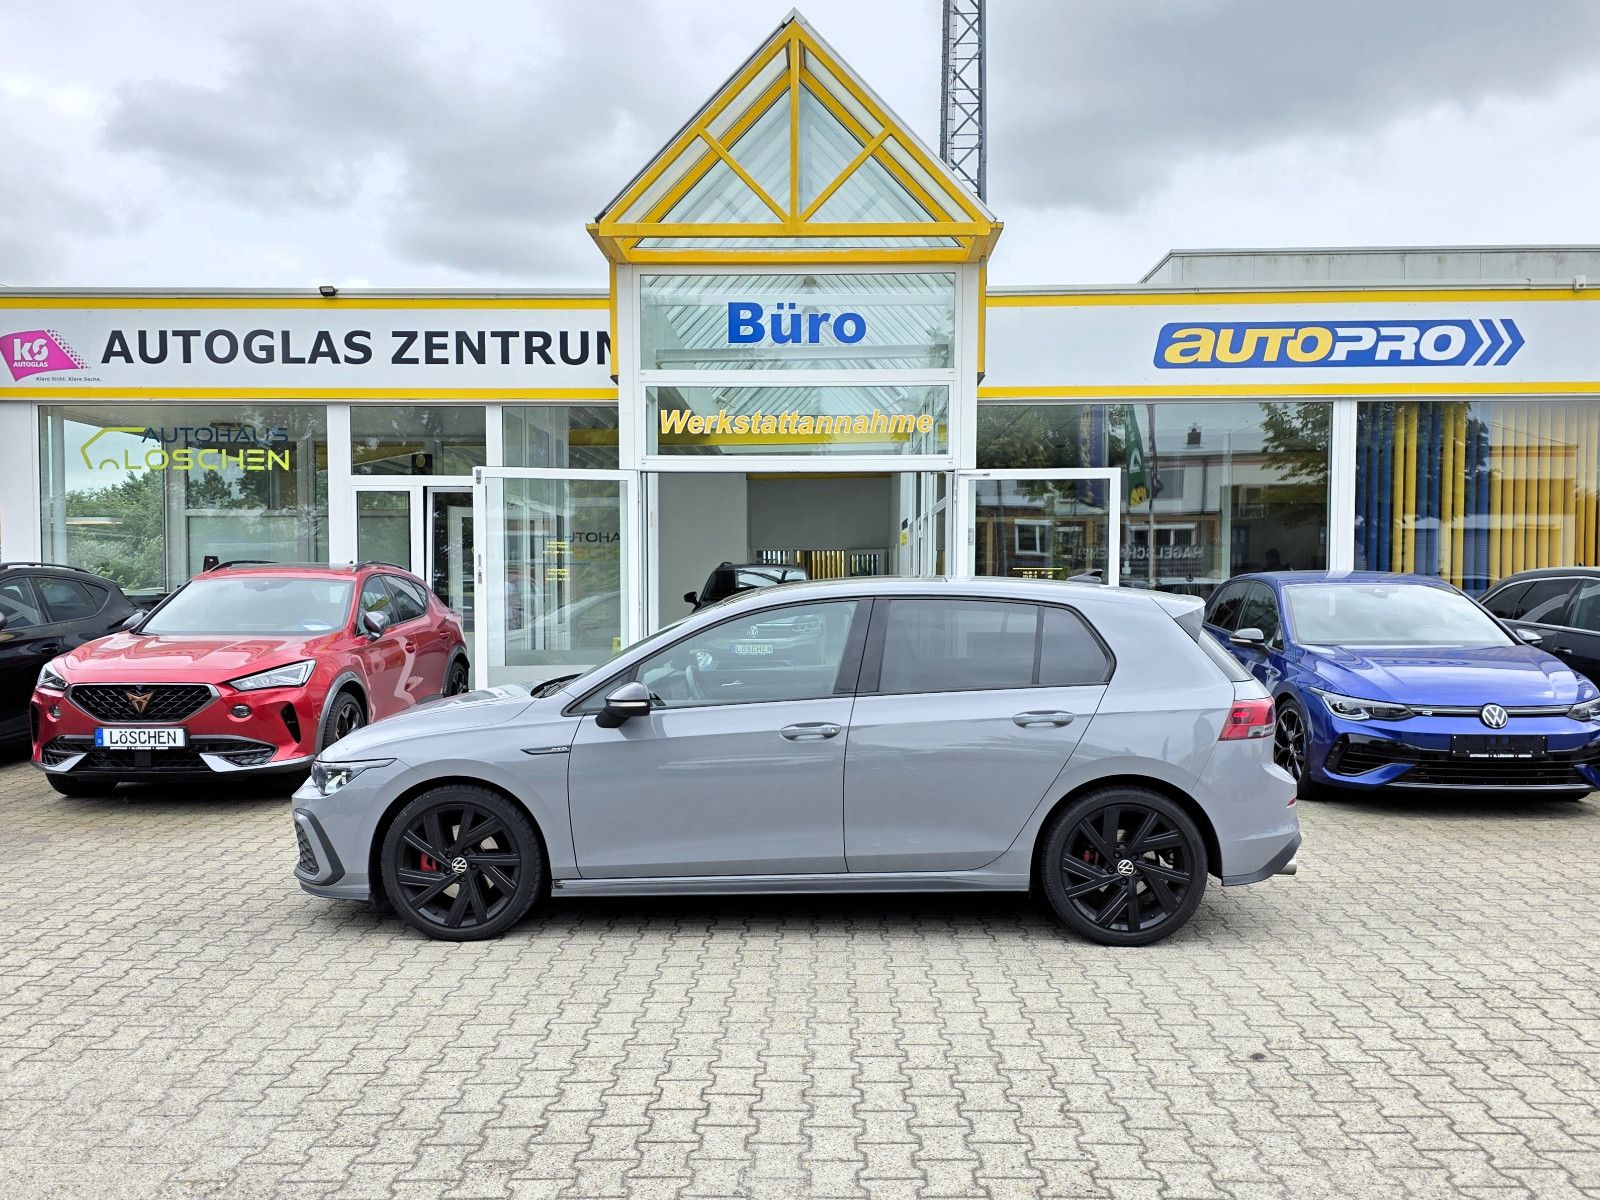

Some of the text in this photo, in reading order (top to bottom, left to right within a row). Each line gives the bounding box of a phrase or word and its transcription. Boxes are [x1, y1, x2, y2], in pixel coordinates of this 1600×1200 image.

[728, 302, 866, 344] Büro
[101, 329, 372, 365] AUTOGLAS
[660, 409, 934, 435] Werkstattannahme
[142, 427, 289, 444] AUTOHAUS
[124, 445, 290, 471] LÖSCHEN
